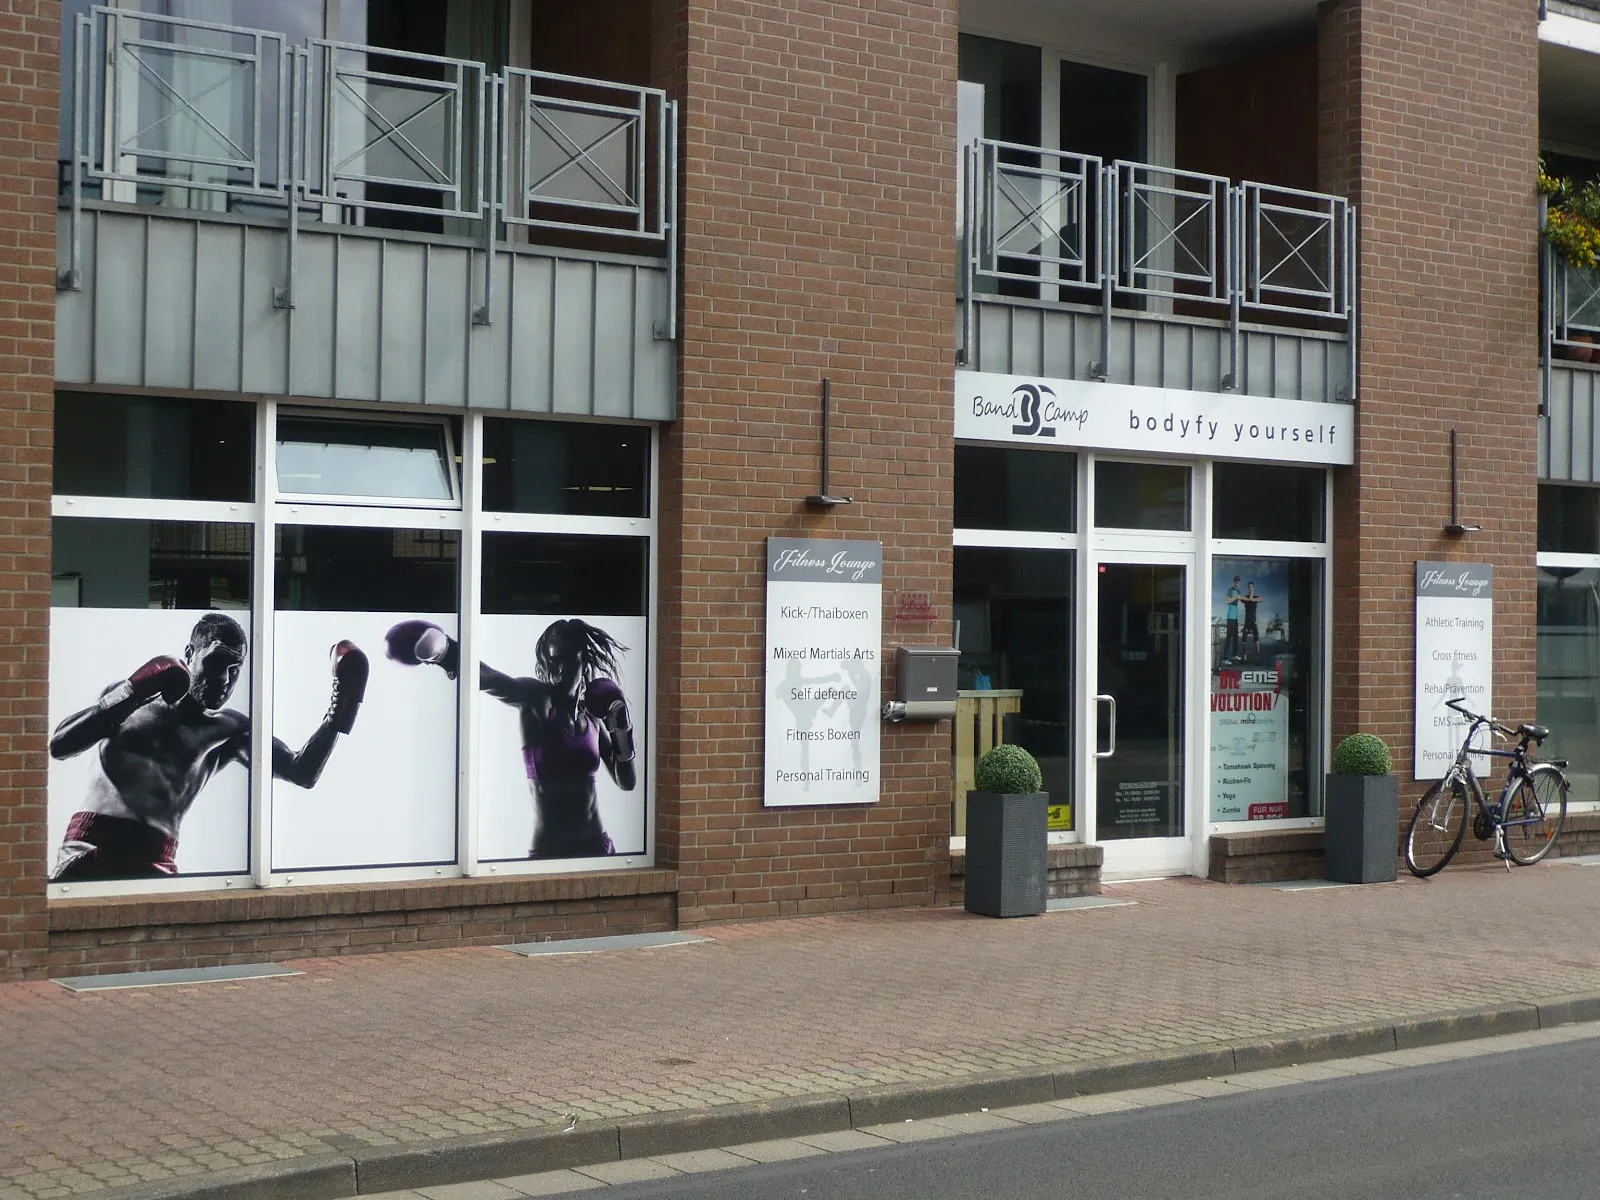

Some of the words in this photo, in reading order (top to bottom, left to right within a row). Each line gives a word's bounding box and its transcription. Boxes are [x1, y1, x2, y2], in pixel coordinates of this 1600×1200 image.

[973, 395, 1019, 419] Band
[1044, 401, 1089, 431] Camp
[1129, 409, 1218, 440] bodyfy
[1234, 423, 1336, 444] yourself
[773, 548, 827, 572] Fitness
[826, 550, 876, 581] Lounge
[1420, 570, 1456, 589] Fitness
[1455, 571, 1489, 596] Lounge
[780, 606, 869, 619] Kick-/Thaiboxen
[1425, 616, 1454, 628] Athletic
[1454, 616, 1485, 631] Training
[773, 647, 807, 660] Mixed
[809, 647, 851, 660] Martials
[853, 648, 875, 660] Arts
[1432, 650, 1452, 661] Cross
[1453, 649, 1477, 661] fitness
[790, 687, 812, 700] Self
[813, 687, 858, 700] defence
[1433, 716, 1451, 727] EMS
[786, 728, 825, 741] Fitness
[827, 728, 861, 740] Boxen
[1422, 749, 1454, 760] Personal
[776, 769, 823, 782] Personal
[825, 768, 870, 783] Training
